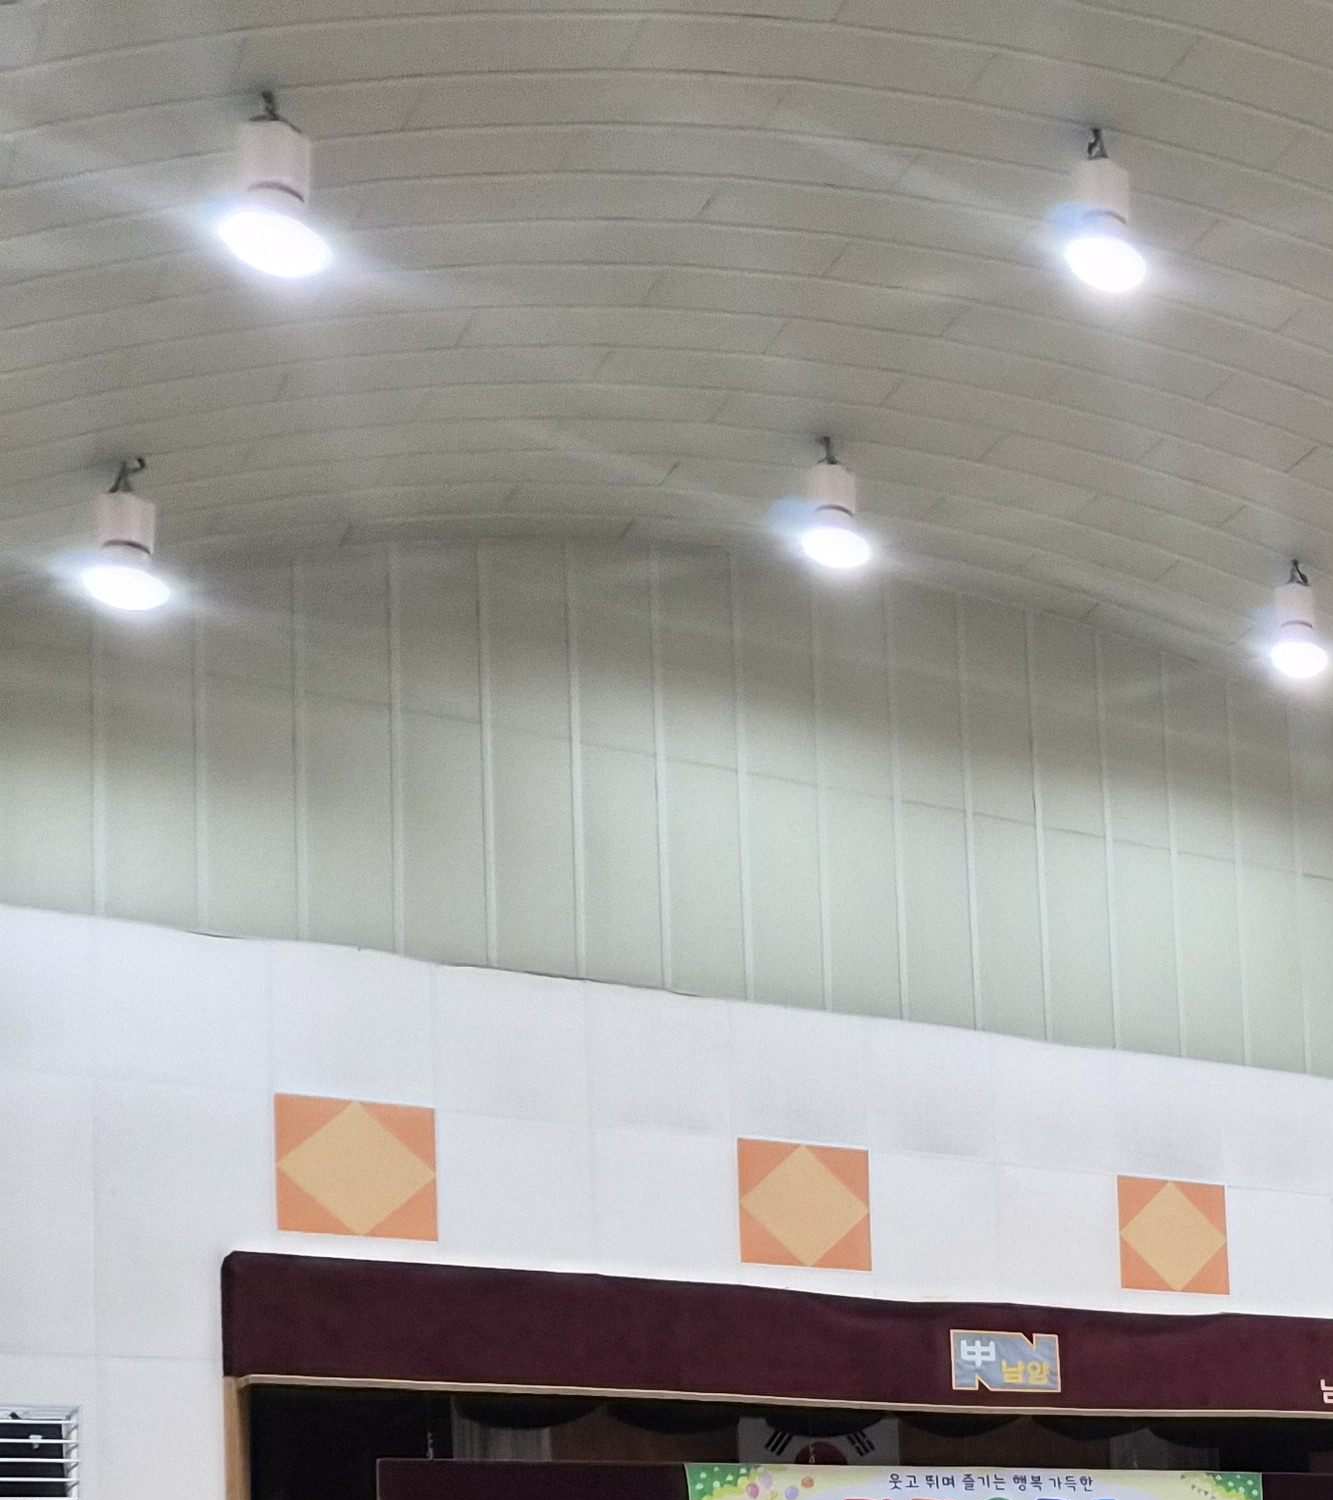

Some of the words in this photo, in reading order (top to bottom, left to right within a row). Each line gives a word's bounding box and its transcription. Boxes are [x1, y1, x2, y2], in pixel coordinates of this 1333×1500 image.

[1001, 1360, 1050, 1385] 남양
[889, 1473, 919, 1490] 웃고
[925, 1474, 955, 1490] 뛰며
[961, 1473, 1006, 1491] 즐기는
[1012, 1474, 1043, 1492] 행복
[1049, 1475, 1094, 1492] 가득한
